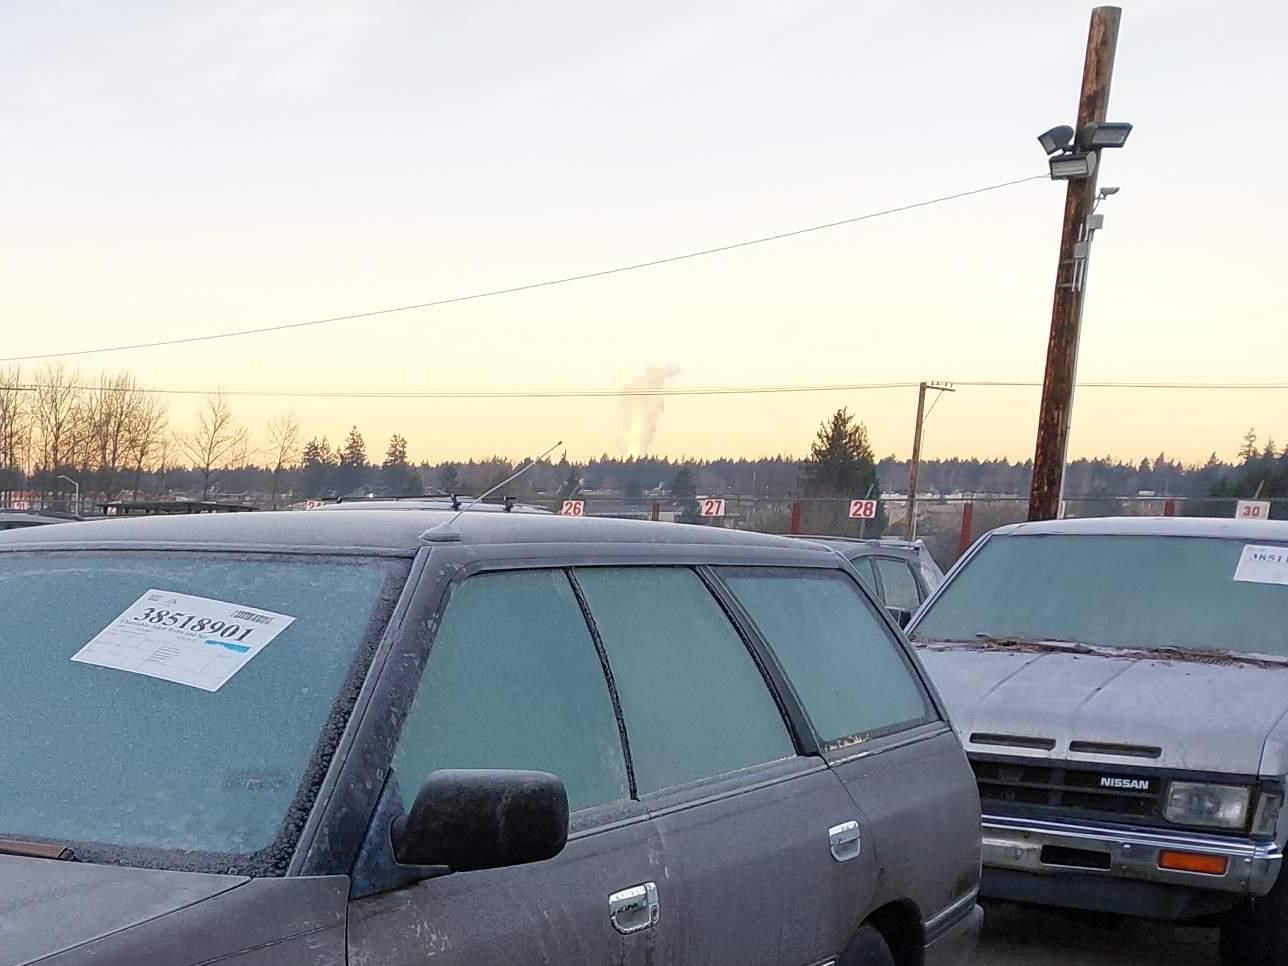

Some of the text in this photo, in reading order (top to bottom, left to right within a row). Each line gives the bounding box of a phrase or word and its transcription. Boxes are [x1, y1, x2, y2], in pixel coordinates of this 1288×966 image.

[564, 501, 582, 515] 26
[705, 500, 723, 515] 27
[852, 501, 874, 517] 28
[1243, 506, 1261, 517] 30
[133, 607, 256, 642] 38518901
[1100, 777, 1149, 790] NISSAN
